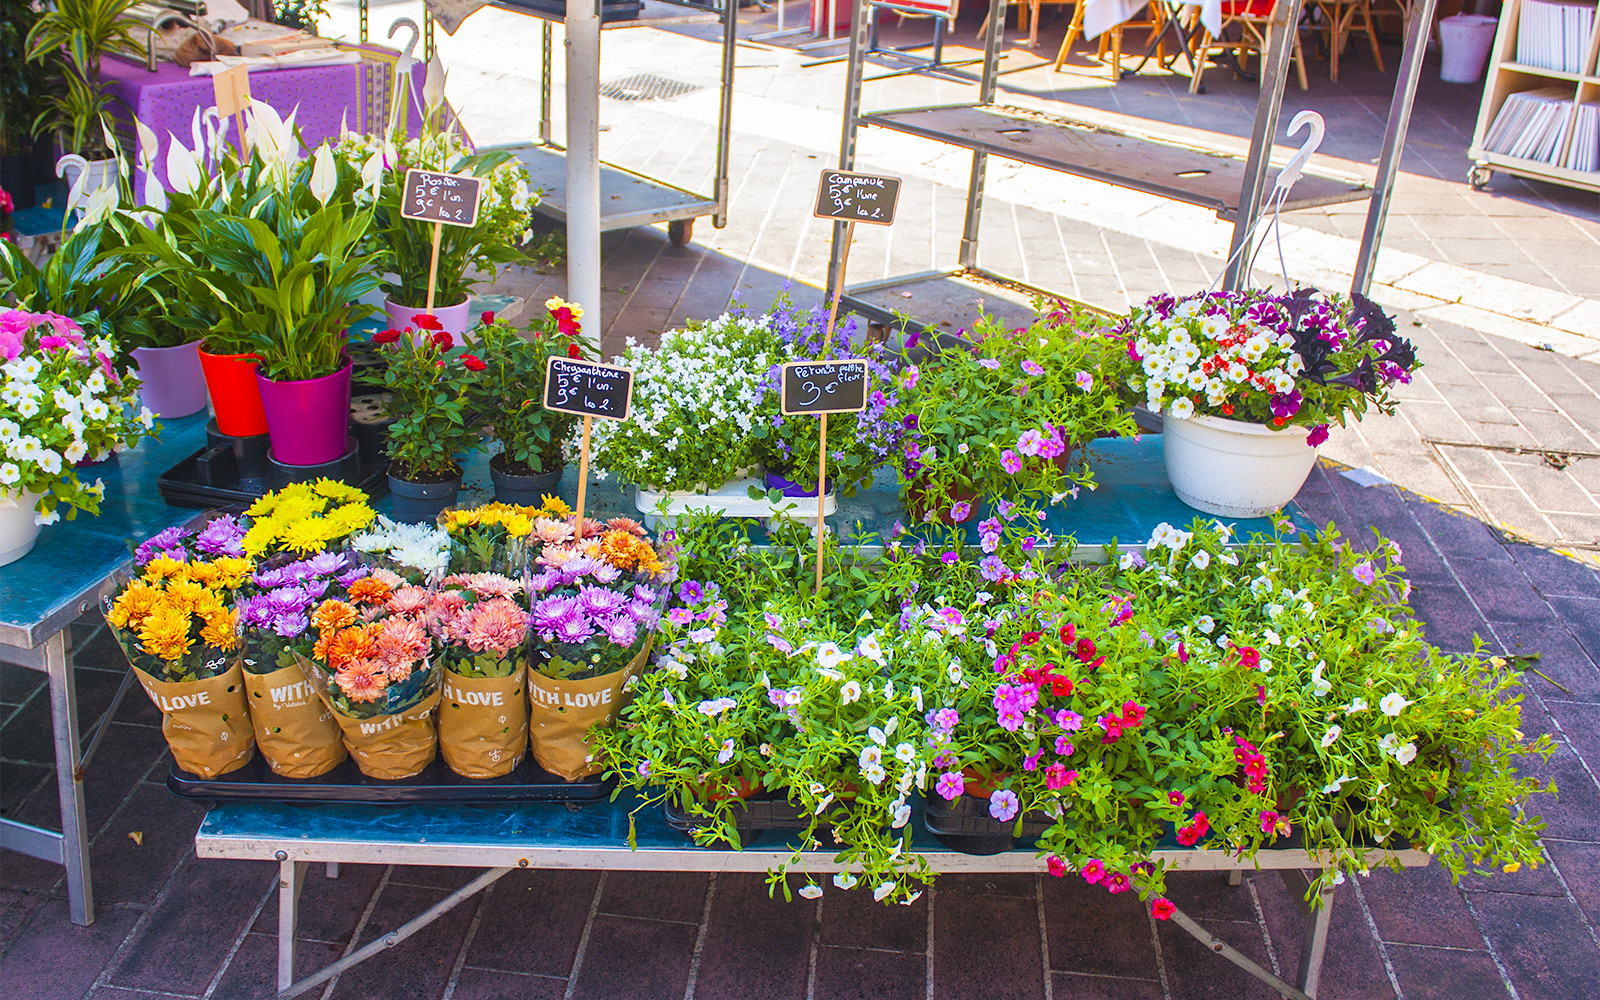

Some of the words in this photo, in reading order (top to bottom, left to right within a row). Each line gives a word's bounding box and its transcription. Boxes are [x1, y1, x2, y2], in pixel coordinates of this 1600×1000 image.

[828, 173, 885, 189] Campanule
[856, 188, 878, 201] l'une
[438, 206, 451, 219] les
[856, 204, 869, 216] les
[270, 679, 316, 703] WITH
[456, 688, 504, 707] LOVE
[564, 687, 612, 708] LOVE
[160, 691, 211, 711] LOVE
[360, 713, 404, 735] WITH
